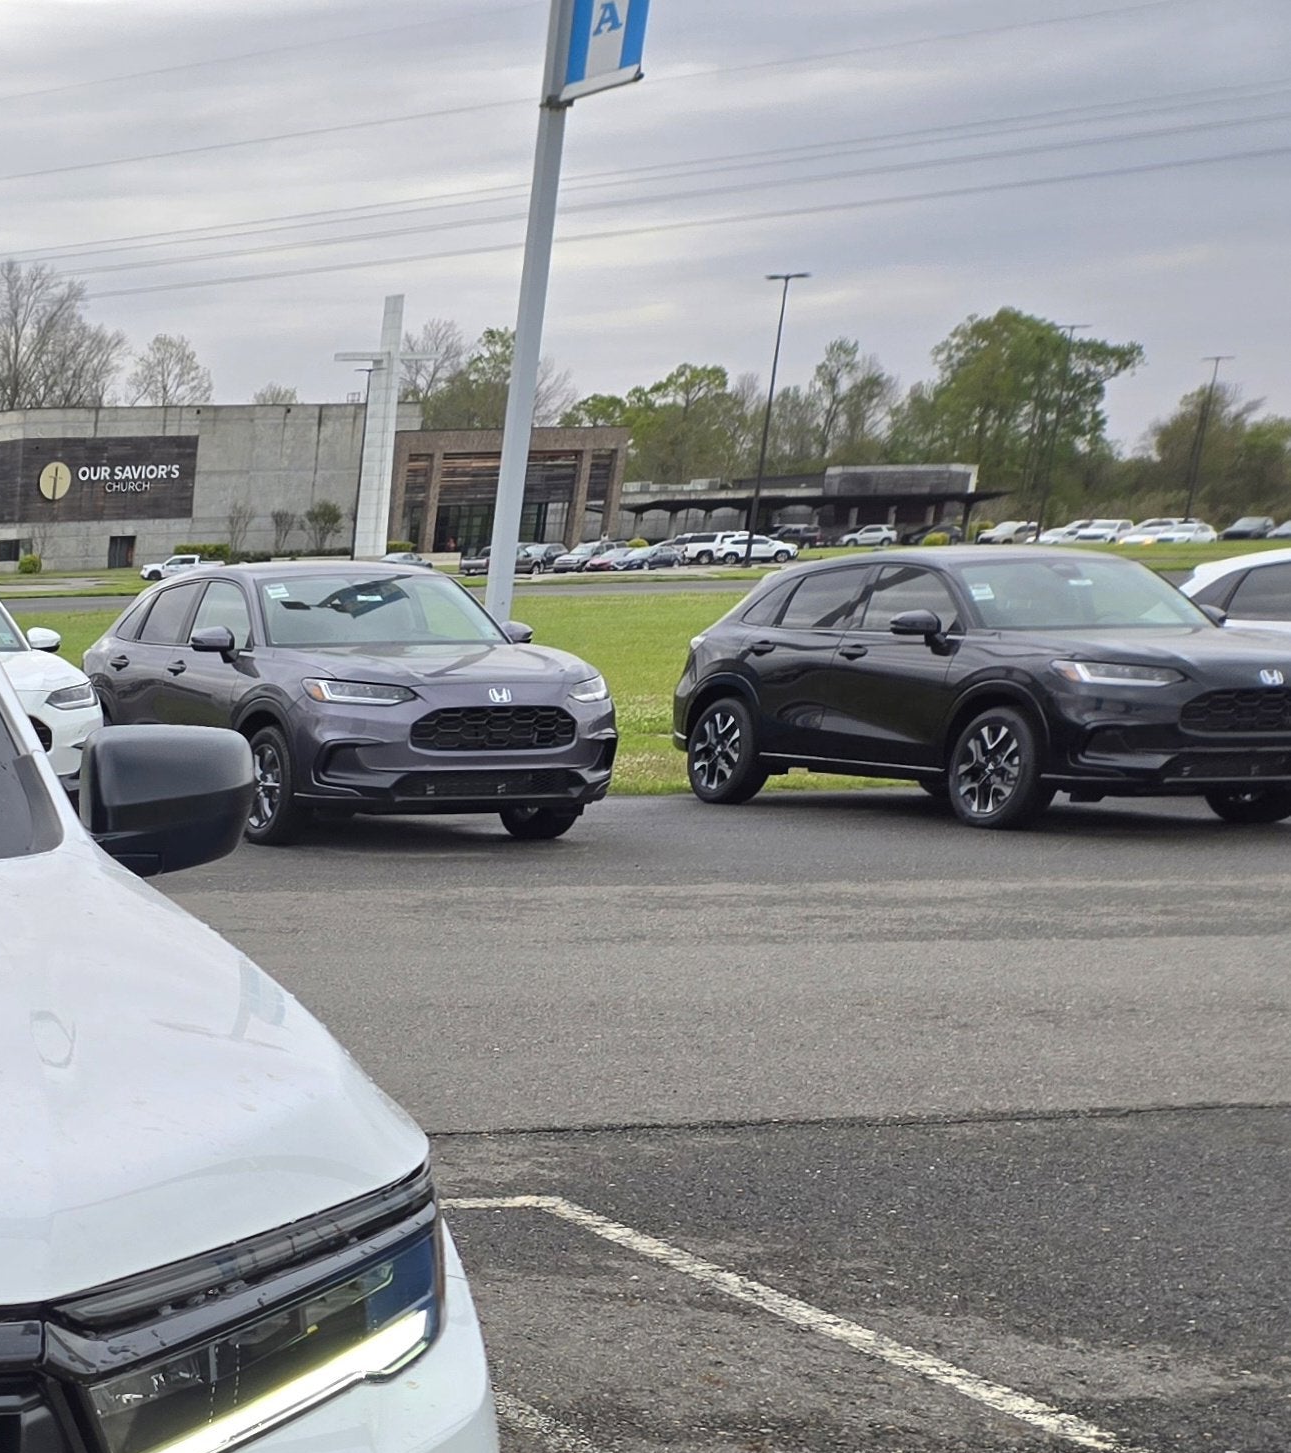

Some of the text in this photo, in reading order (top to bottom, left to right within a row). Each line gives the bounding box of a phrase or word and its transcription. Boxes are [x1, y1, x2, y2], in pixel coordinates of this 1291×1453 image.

[78, 464, 180, 481] OUR SAVIOR'S
[105, 481, 151, 492] CHURCH
